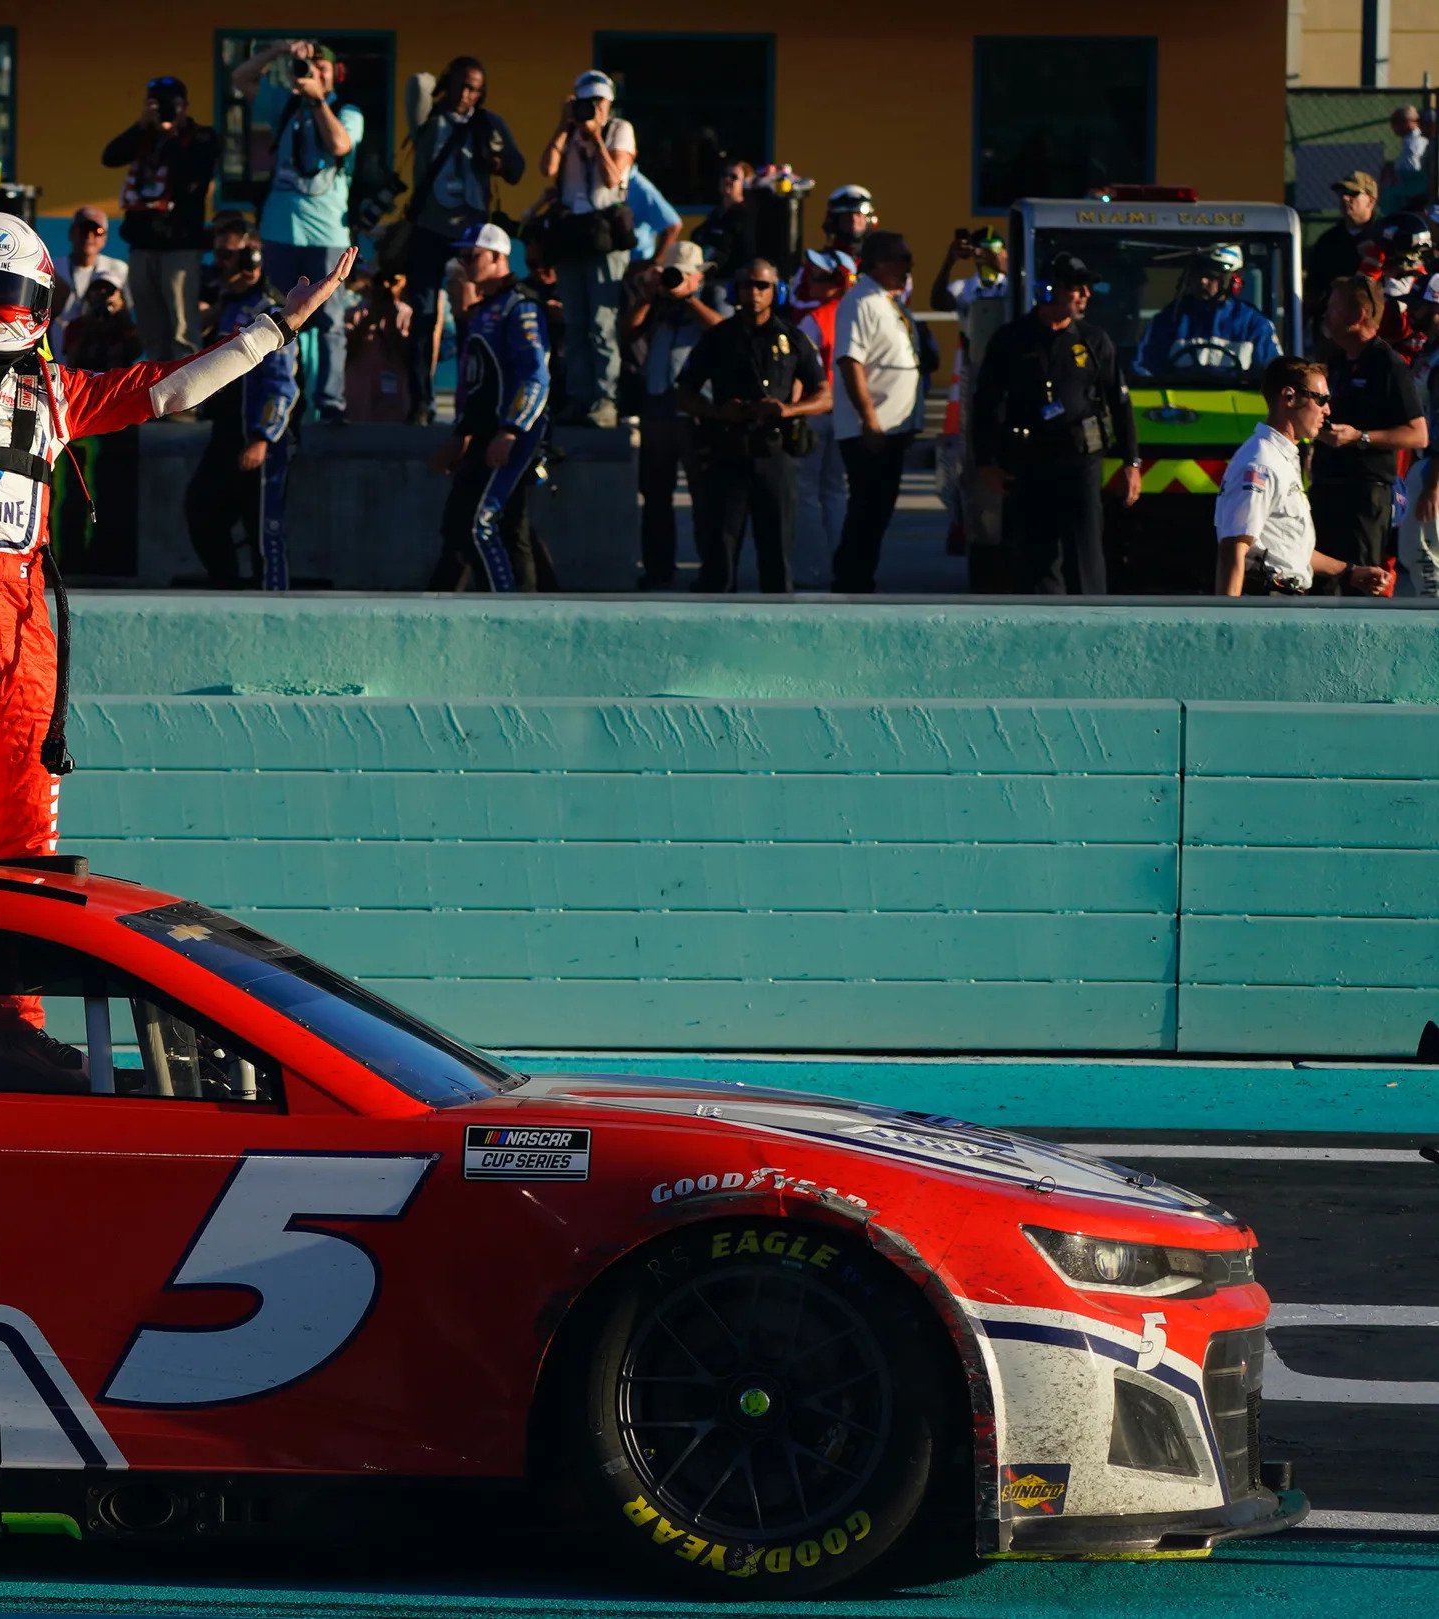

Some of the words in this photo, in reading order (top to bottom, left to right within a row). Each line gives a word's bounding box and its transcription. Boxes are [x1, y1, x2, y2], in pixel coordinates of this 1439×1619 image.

[1077, 211, 1157, 224] MIAMI
[505, 1131, 572, 1147] NASCAR
[481, 1153, 515, 1168] CUP
[515, 1153, 572, 1169] SERIES
[711, 1230, 841, 1270] EAGLE
[96, 1149, 444, 1410] 5
[1136, 1311, 1168, 1372] 5
[1002, 1484, 1065, 1502] SUNOCO
[622, 1494, 872, 1578] GOODYEAR
